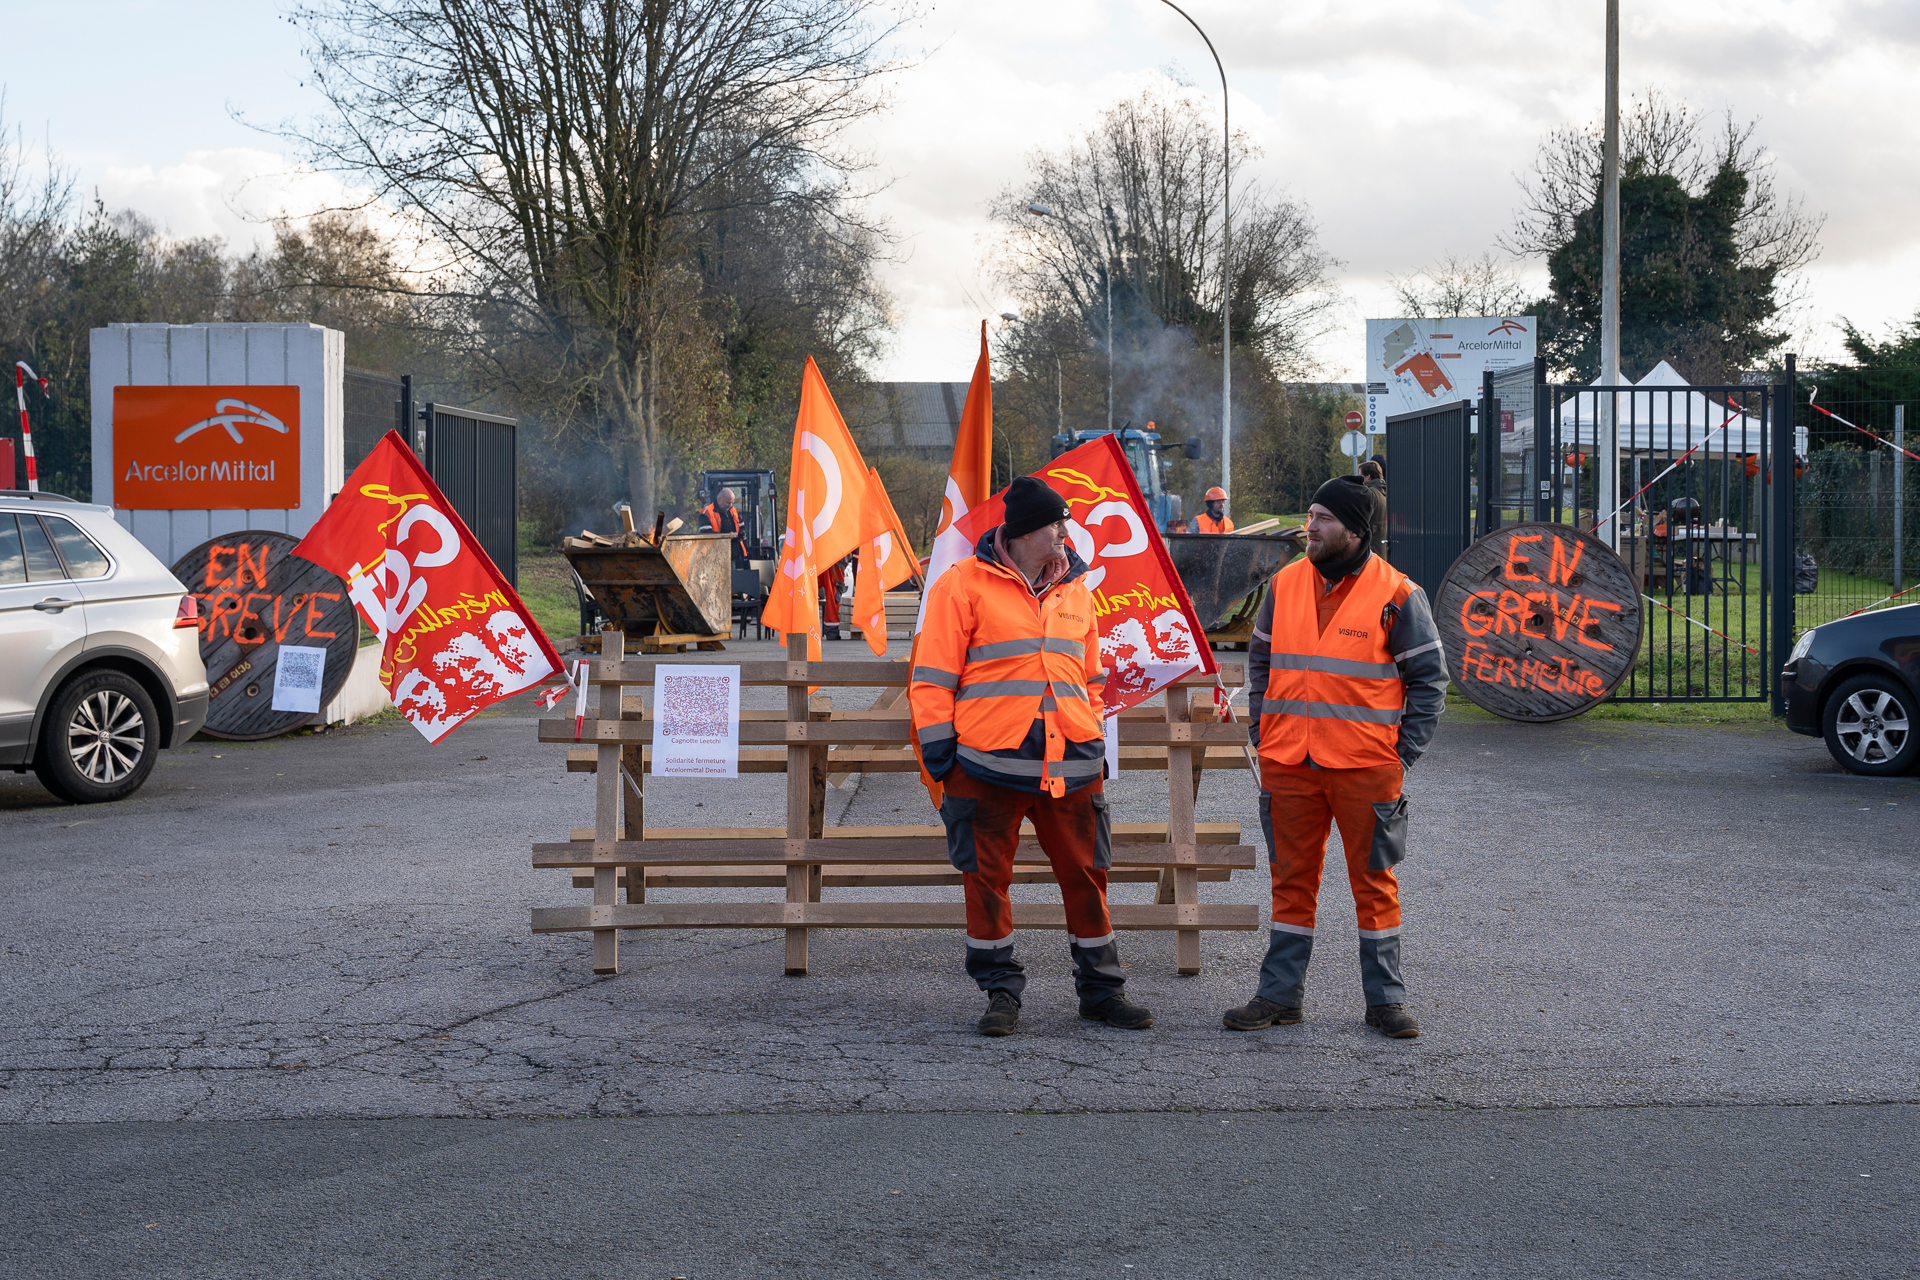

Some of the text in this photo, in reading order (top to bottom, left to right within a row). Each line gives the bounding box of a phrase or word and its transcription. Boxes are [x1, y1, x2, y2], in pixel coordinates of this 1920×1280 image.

[1457, 340, 1522, 351] ArcelorMittal
[125, 460, 275, 482] ArcelorMittal
[205, 543, 269, 589] EN
[1504, 534, 1584, 587] EN
[1057, 612, 1084, 624] VISITOR
[1460, 588, 1621, 652] GREVE
[1338, 628, 1369, 639] VISITOR
